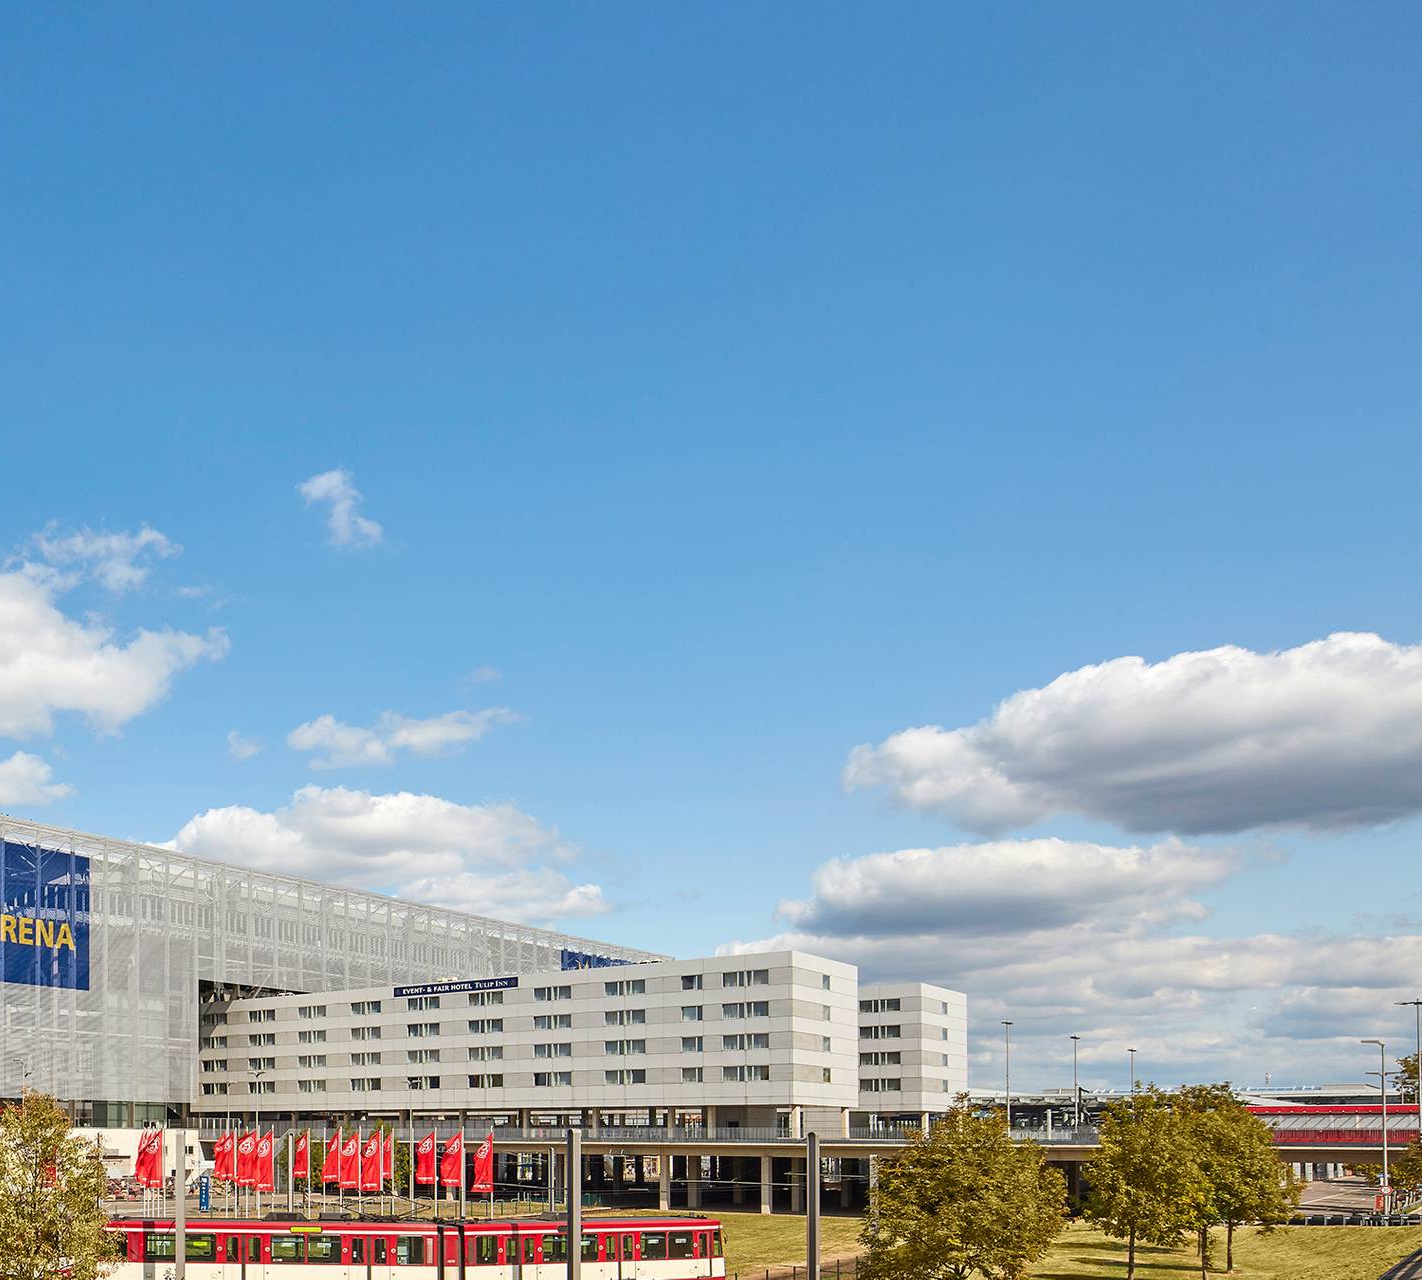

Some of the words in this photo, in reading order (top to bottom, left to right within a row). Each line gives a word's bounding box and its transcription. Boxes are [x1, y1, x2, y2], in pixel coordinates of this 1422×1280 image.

[402, 987, 426, 995] EVENT-
[450, 983, 473, 991] HOTEL
[474, 981, 494, 989] TULIP
[495, 979, 509, 987] INN
